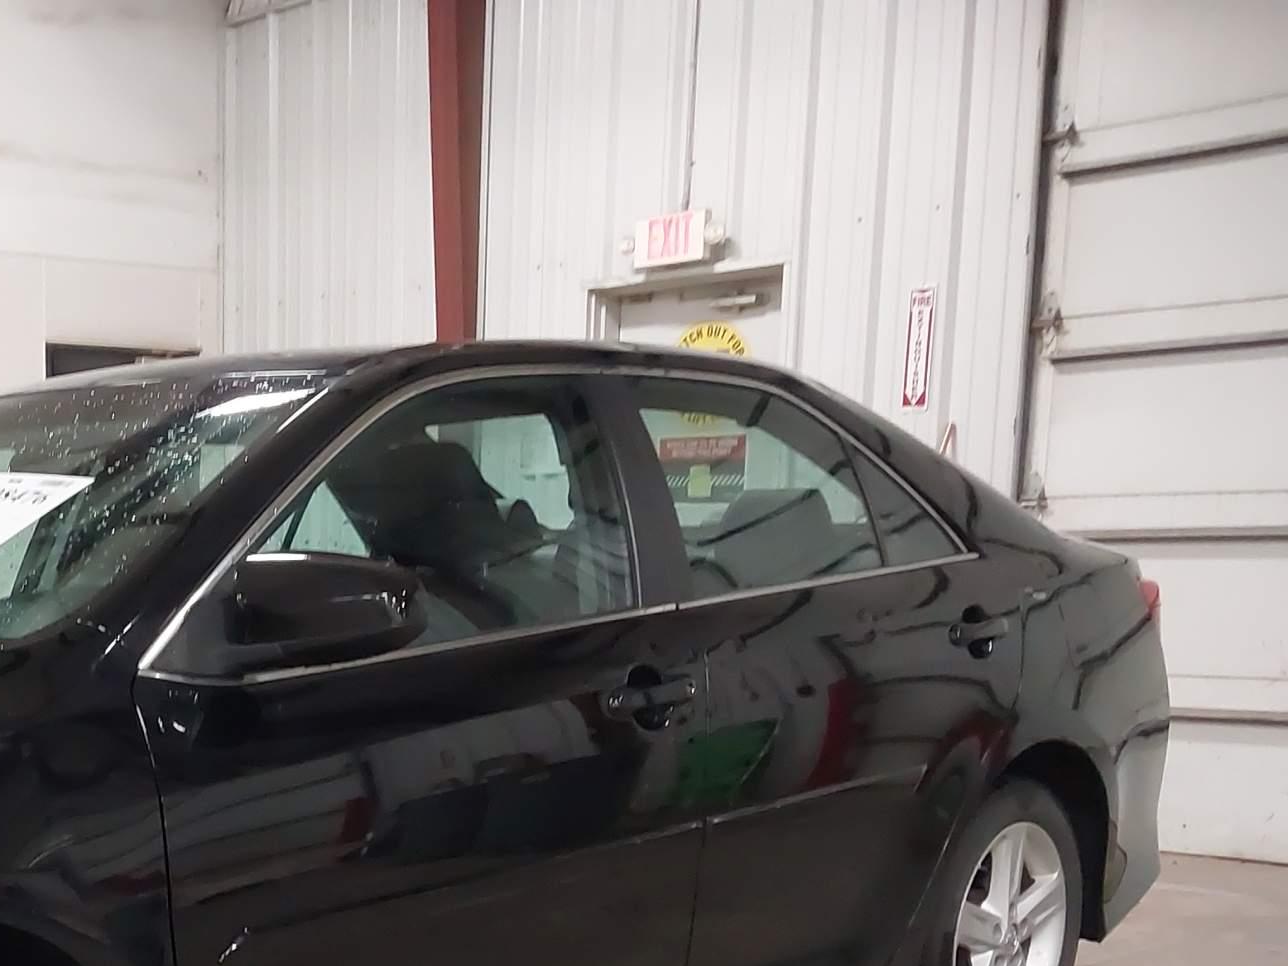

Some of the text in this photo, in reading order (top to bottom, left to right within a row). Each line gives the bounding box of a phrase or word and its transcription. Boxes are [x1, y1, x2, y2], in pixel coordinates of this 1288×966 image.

[647, 213, 693, 260] EXIT
[912, 295, 932, 307] FIRE
[706, 323, 727, 340] OUT
[726, 334, 746, 357] FOR
